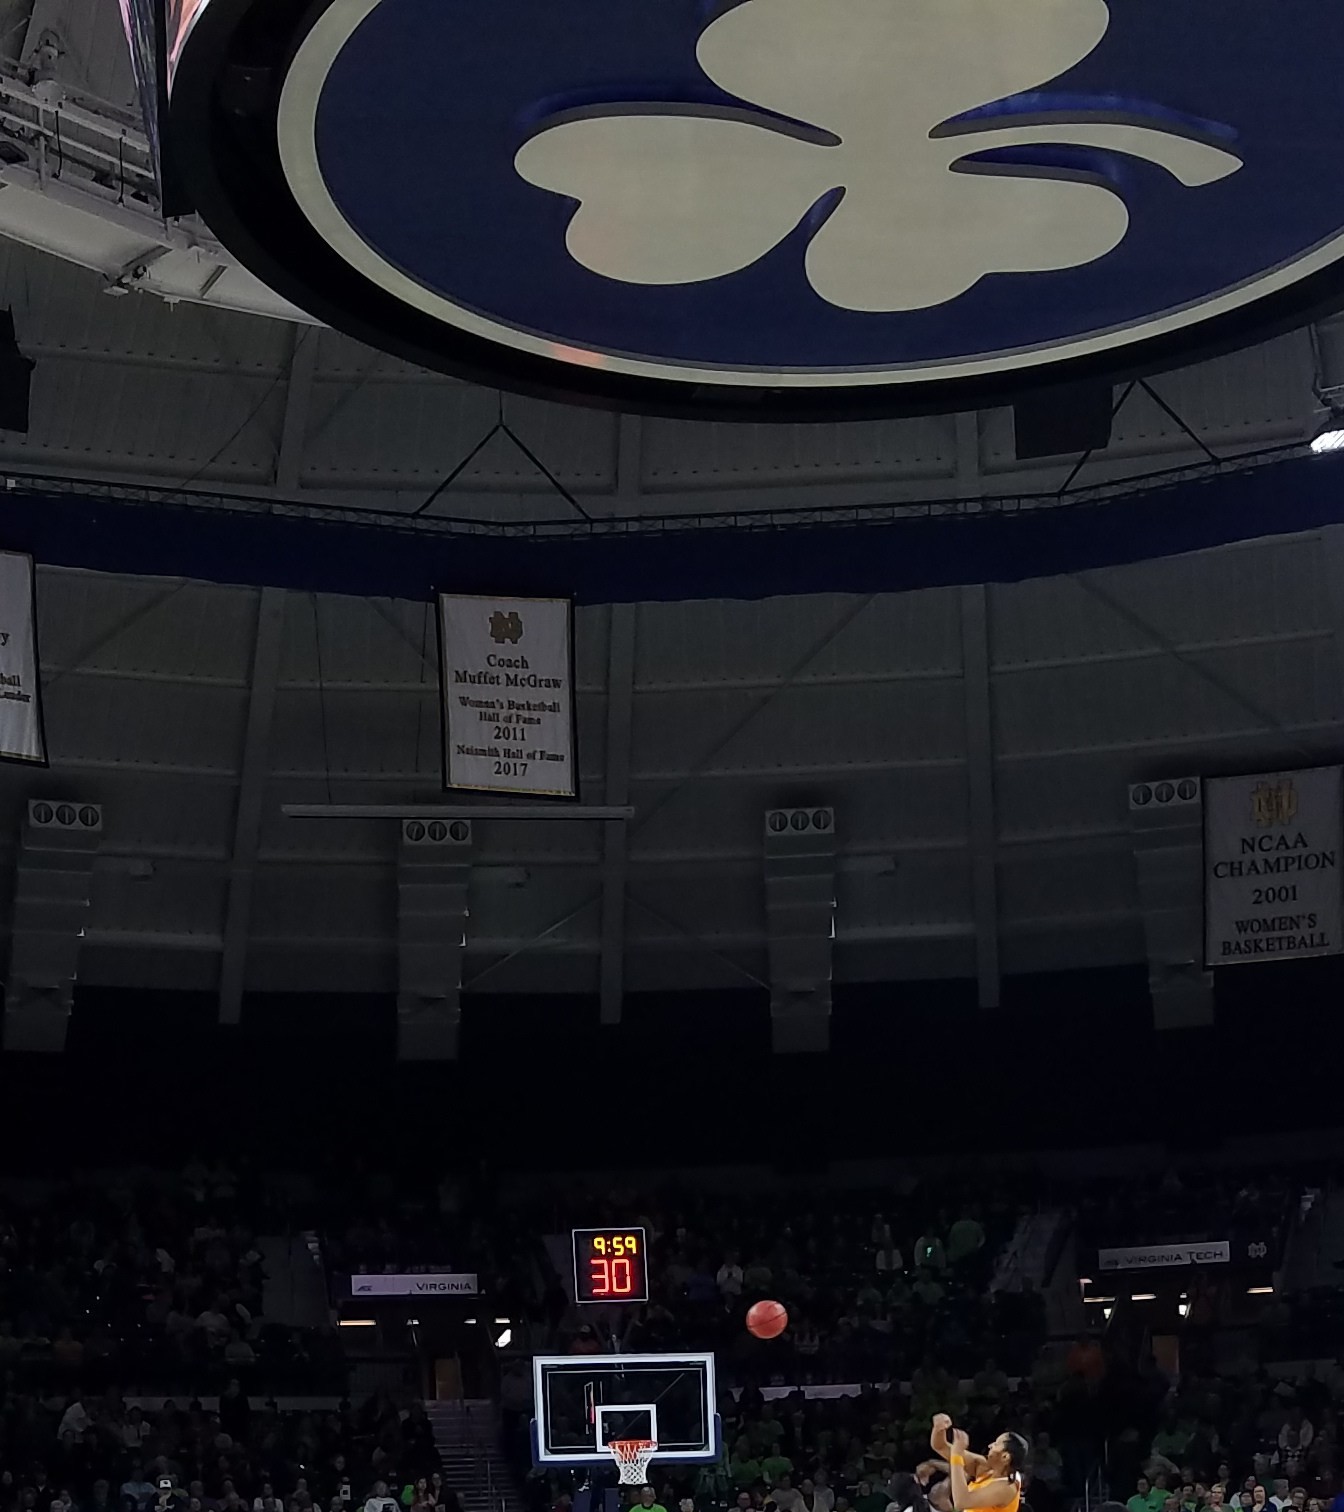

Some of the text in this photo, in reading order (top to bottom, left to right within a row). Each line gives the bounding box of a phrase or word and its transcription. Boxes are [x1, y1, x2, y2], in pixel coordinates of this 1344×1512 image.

[486, 654, 529, 669] Coach
[454, 670, 562, 689] Muffet McGraw
[508, 700, 560, 712] Basketball
[479, 711, 541, 725] Hall of Fame
[494, 726, 526, 741] 2011
[503, 748, 523, 759] Hall
[526, 751, 536, 760] of
[539, 751, 564, 762] Fame
[494, 761, 528, 776] 2017
[1241, 833, 1308, 854] NCAA
[1213, 851, 1336, 879] CHAMPION
[1252, 886, 1298, 905] 2001
[1235, 913, 1317, 934] WOMEN'S
[1221, 933, 1330, 956] BASKETBALL
[593, 1236, 637, 1256] 9:59
[591, 1258, 631, 1293] 30
[416, 1282, 472, 1291] VIRGINIA
